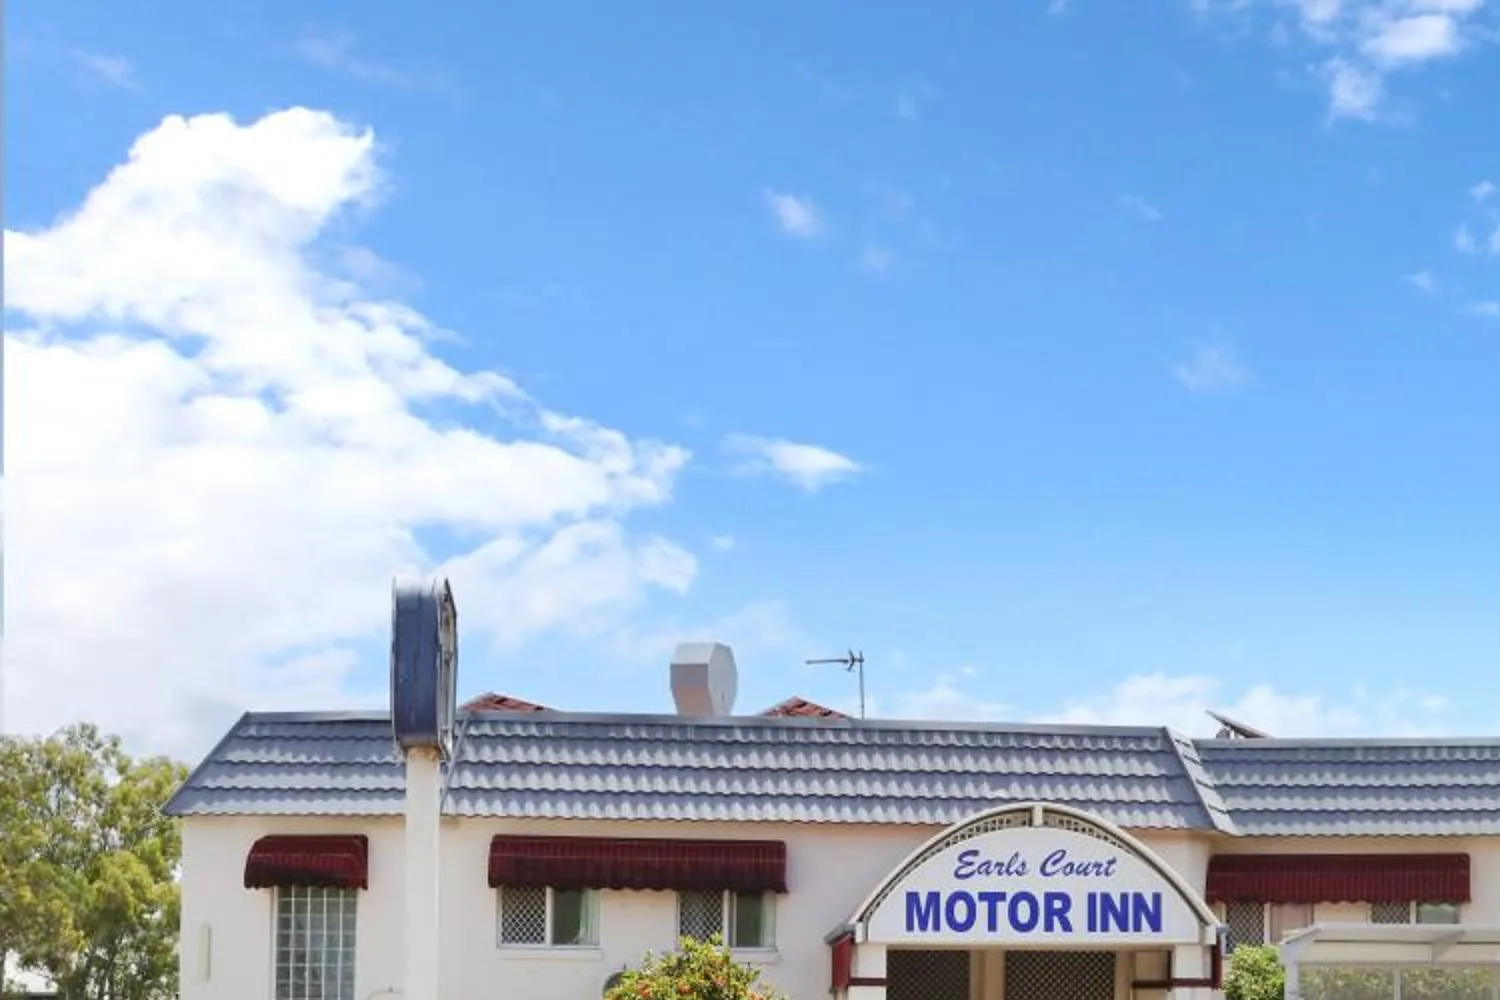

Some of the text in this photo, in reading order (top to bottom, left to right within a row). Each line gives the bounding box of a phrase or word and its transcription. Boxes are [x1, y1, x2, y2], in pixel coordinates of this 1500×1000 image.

[953, 849, 1118, 880] Earls Court
[905, 890, 1163, 933] MOTOR INN
